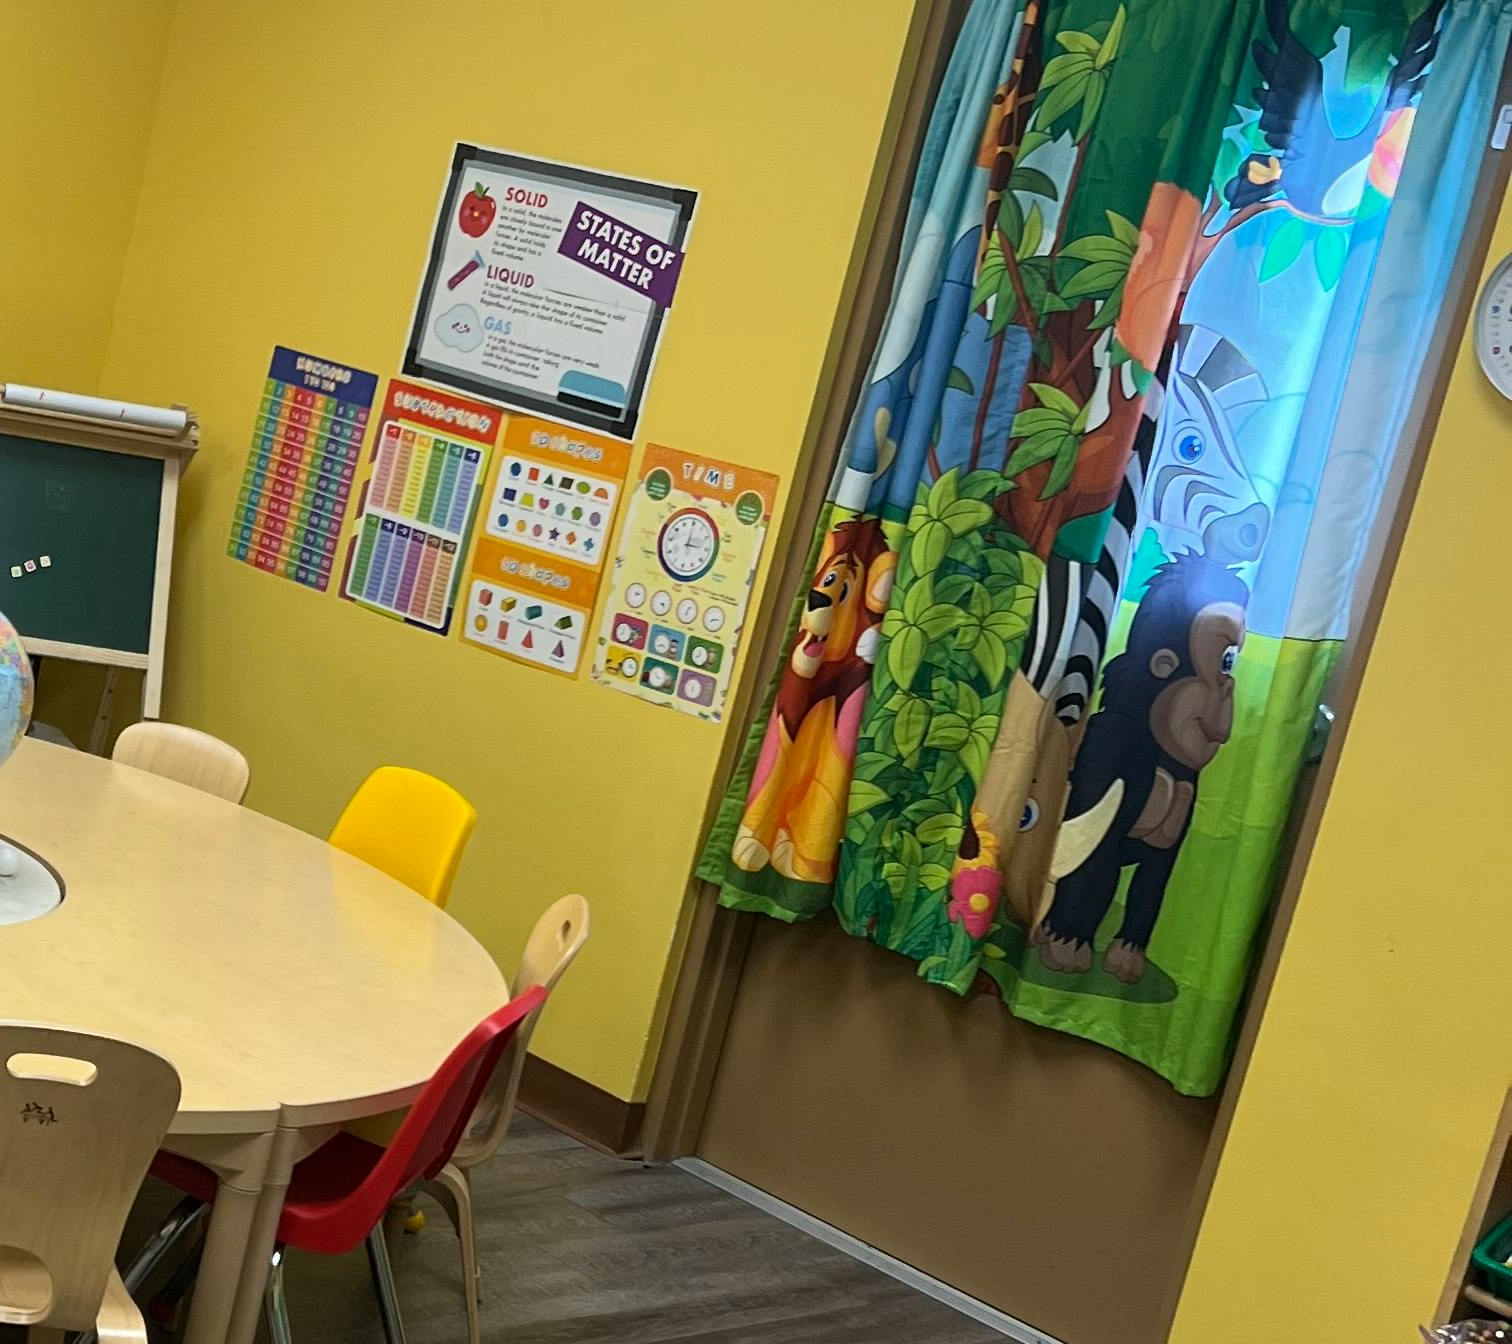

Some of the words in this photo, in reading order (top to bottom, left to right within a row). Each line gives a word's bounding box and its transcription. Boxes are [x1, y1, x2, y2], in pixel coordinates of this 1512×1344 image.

[504, 187, 548, 208] SOLID
[576, 210, 642, 256] STATES
[645, 244, 676, 271] OF
[486, 264, 535, 288] LIQUID
[576, 237, 654, 290] MATTER
[484, 316, 512, 335] GAS
[682, 462, 735, 490] TIME
